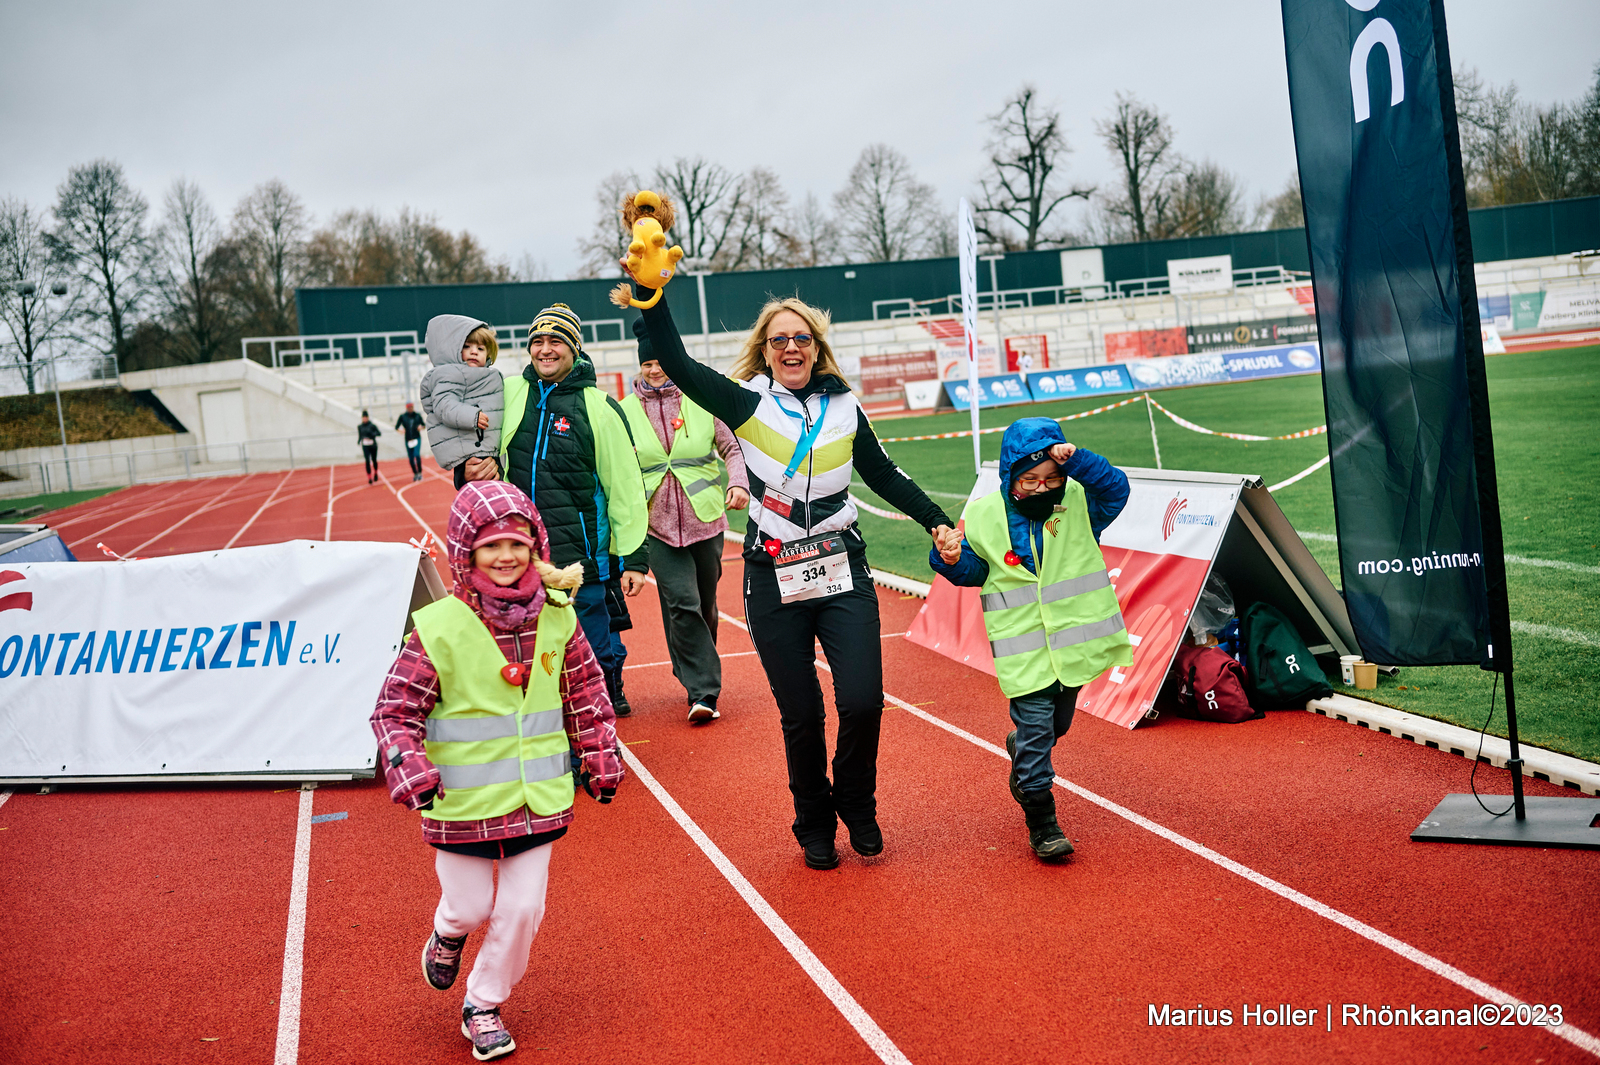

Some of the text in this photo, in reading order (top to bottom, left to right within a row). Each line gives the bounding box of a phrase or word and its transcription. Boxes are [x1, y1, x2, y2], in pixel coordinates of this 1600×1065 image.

[801, 549, 820, 559] ULTRA
[802, 565, 827, 582] 334
[826, 583, 842, 594] 334
[0, 620, 297, 679] ONTANHERZEN
